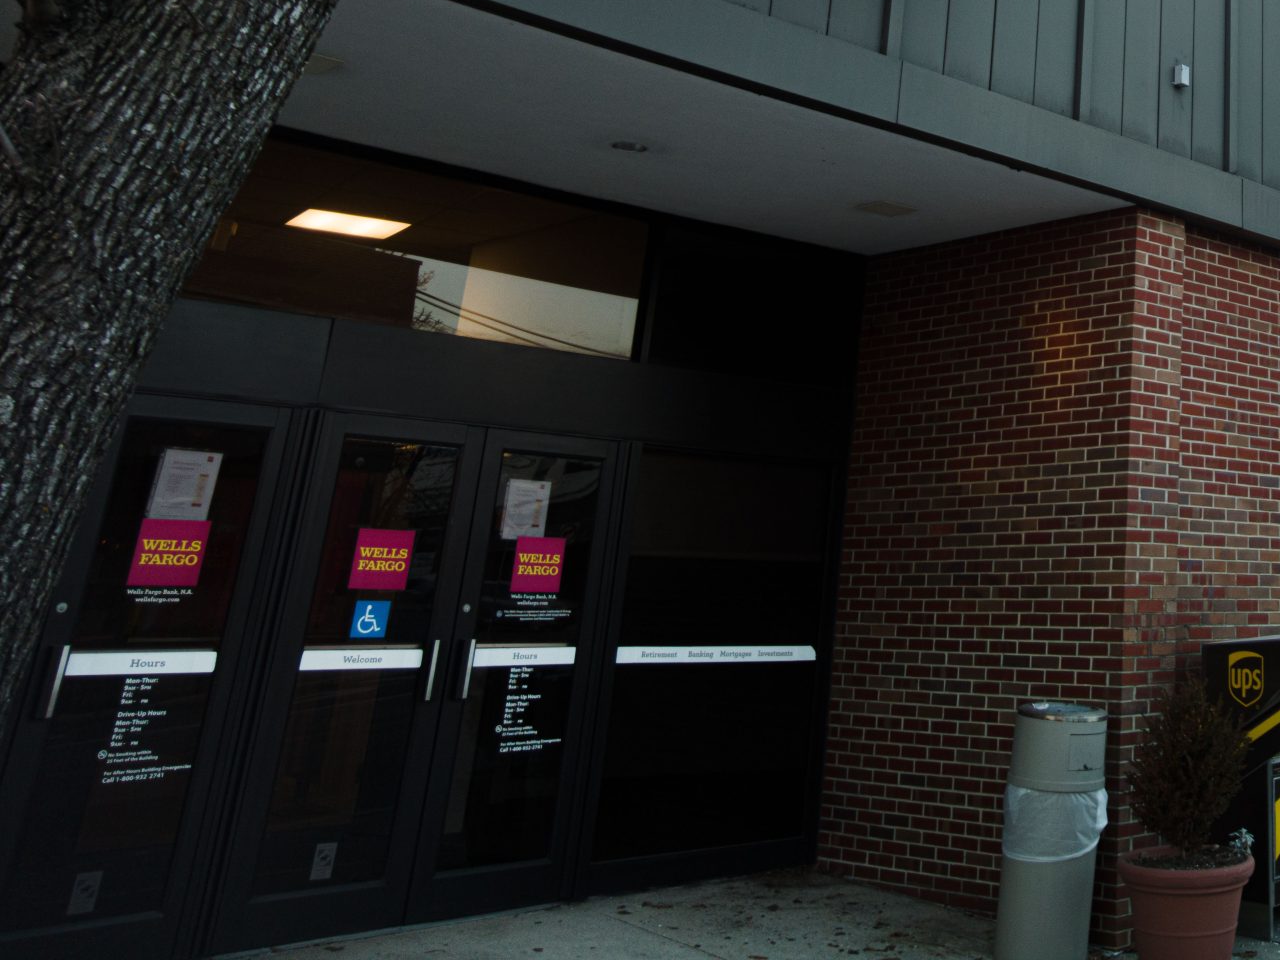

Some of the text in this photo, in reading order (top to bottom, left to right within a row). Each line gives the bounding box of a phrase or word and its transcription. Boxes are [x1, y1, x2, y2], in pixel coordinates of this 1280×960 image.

[142, 539, 202, 552] WELLS
[359, 546, 409, 559] WELLS
[138, 553, 199, 566] FARGO
[518, 553, 561, 564] WELLS
[357, 559, 406, 572] FARGO
[517, 564, 559, 576] FARGO
[144, 588, 162, 596] Fargo
[135, 596, 181, 604] wellsfargo.com
[512, 651, 538, 660] Hours
[641, 649, 793, 659] Retirement Banking Mortgages Investments
[129, 658, 167, 668] Hours
[342, 655, 383, 665] Welcome
[125, 677, 159, 685] Mon-Thur:
